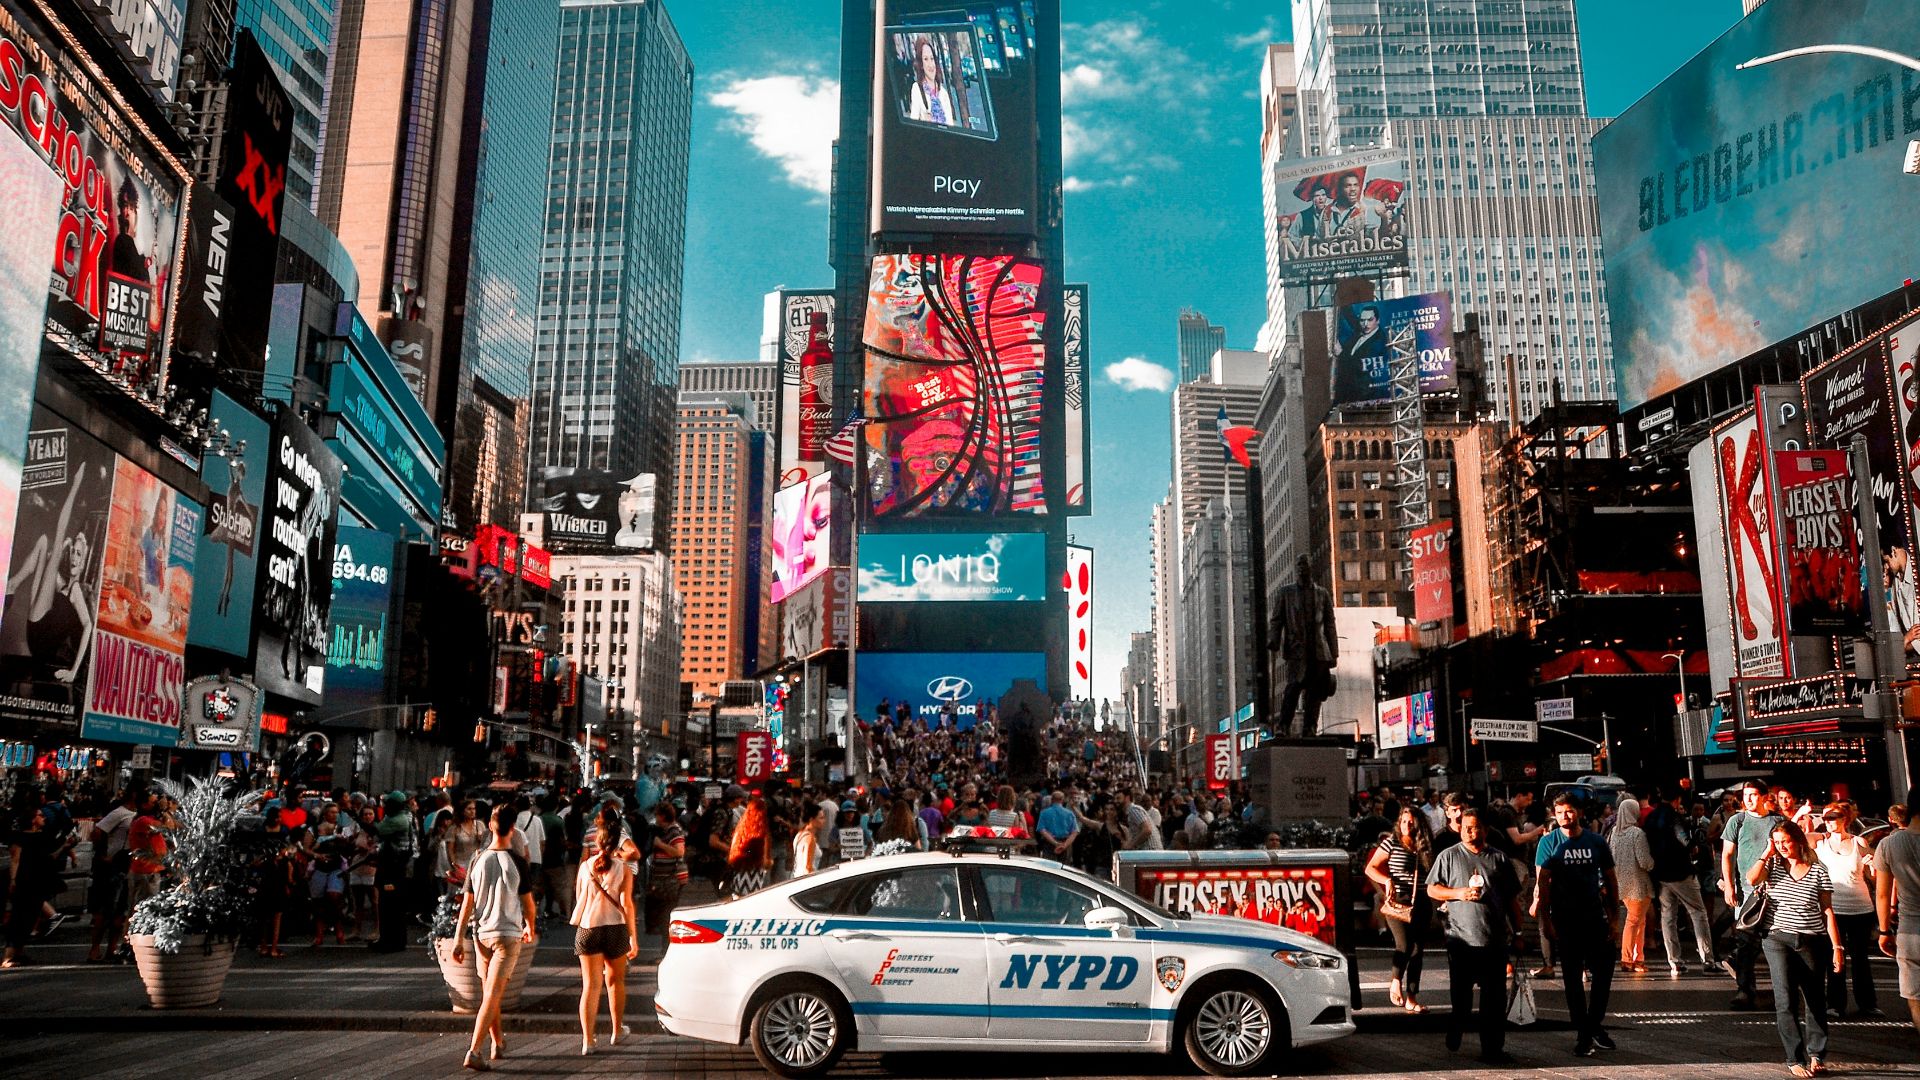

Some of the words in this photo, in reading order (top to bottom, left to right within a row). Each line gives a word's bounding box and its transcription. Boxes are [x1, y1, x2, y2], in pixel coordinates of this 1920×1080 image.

[58, 49, 87, 91] ANDREW
[87, 81, 108, 115] LLOYD
[107, 108, 132, 144] WEBBER
[41, 48, 57, 84] THE
[111, 130, 143, 180] MESSAGE
[0, 38, 108, 226] SCHOOL
[1277, 169, 1300, 180] FINAL
[1301, 162, 1335, 175] MONTHS
[933, 175, 982, 199] Play
[906, 206, 947, 214] Unbreakable
[947, 207, 969, 216] Kimmy
[1004, 208, 1025, 216] Netflix
[1324, 221, 1354, 239] Les
[55, 211, 107, 322] CK
[203, 210, 231, 318] NEW
[1366, 254, 1394, 262] THEATRE
[107, 281, 149, 318] BEST
[1391, 310, 1410, 319] LET
[1412, 306, 1440, 317] YOUR
[105, 311, 148, 335] MUSICAL!
[1361, 346, 1451, 372] PHOM
[921, 384, 941, 399] day
[1825, 358, 1867, 400] Winner!
[1828, 398, 1836, 416] 4
[1847, 386, 1865, 402] AWARDS
[1652, 411, 1672, 423] outdoor
[1824, 416, 1845, 441] Best
[1845, 398, 1880, 428] Musical!
[28, 436, 65, 461] YEARS
[281, 435, 295, 471] Go
[276, 477, 300, 512] your
[1785, 478, 1848, 518] JERSEY
[174, 503, 199, 534] BEST
[1796, 511, 1843, 549] BOYS
[272, 515, 306, 557] routine
[268, 553, 297, 590] can't.
[901, 553, 1000, 583] IONIQ
[991, 586, 1014, 594] SHOW
[1762, 656, 1775, 666] BEST
[1764, 641, 1776, 657] TONY
[91, 632, 184, 728] WAITRESS
[0, 694, 75, 715] AGOTHEMUSICAL.COM
[1473, 721, 1502, 730] PEDESTRIAN
[1502, 722, 1516, 730] FLOW
[1516, 723, 1528, 731] ZONE
[1498, 730, 1510, 738] KEEP
[1510, 731, 1529, 739] MOVING
[1563, 848, 1592, 860] ANU
[1153, 879, 1248, 916] JERSEY
[1254, 879, 1327, 922] BOYS
[724, 918, 827, 937] TRAFFIC
[760, 937, 777, 950] SPL
[781, 937, 799, 950] OPS
[999, 953, 1140, 991] NYPD
